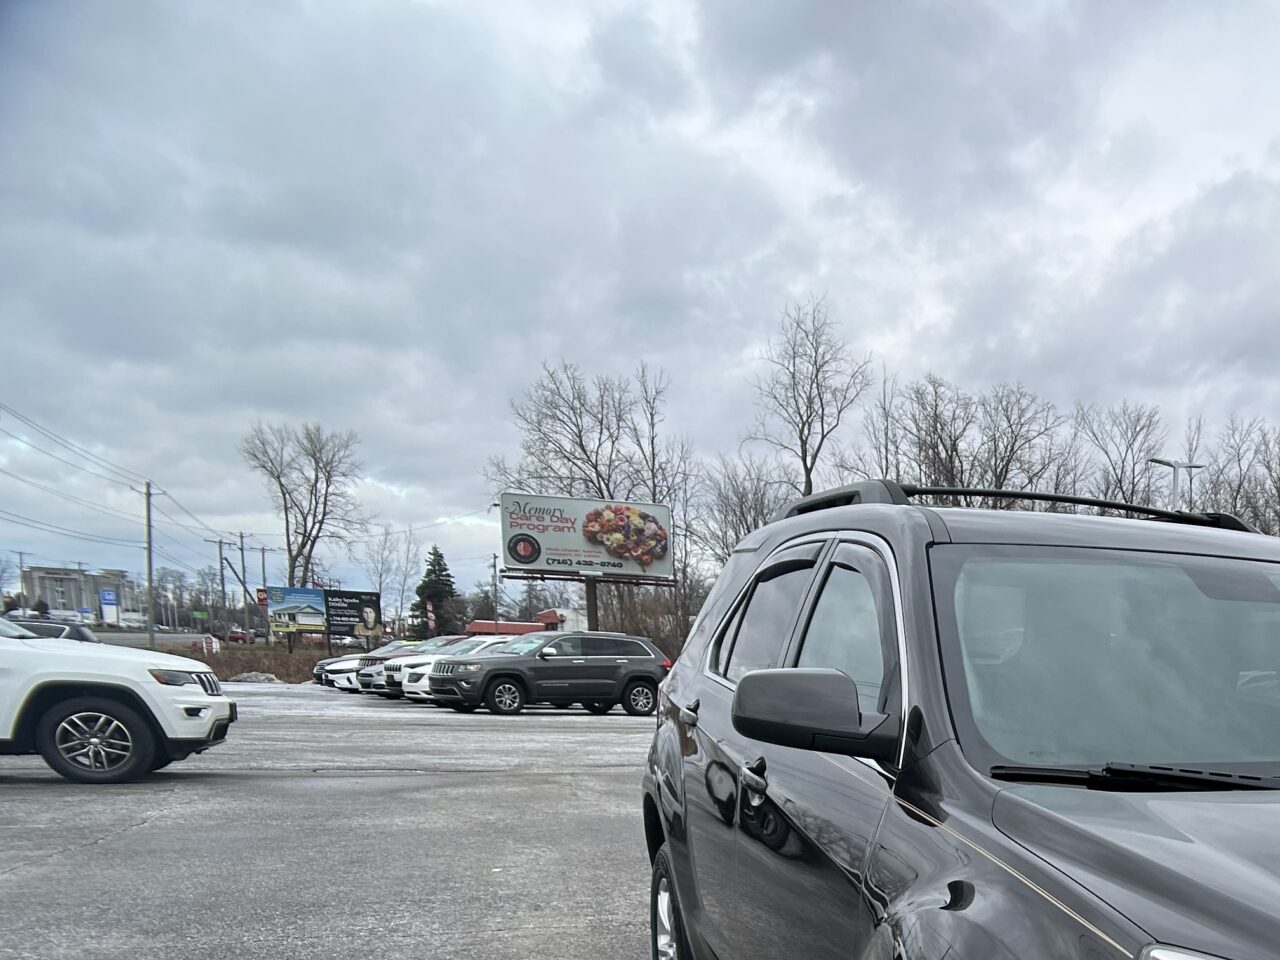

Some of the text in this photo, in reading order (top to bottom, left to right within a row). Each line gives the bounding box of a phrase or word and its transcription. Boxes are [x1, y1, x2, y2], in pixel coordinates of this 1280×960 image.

[504, 501, 565, 518] Memory
[509, 512, 577, 526] Care Day
[509, 521, 577, 533] Program
